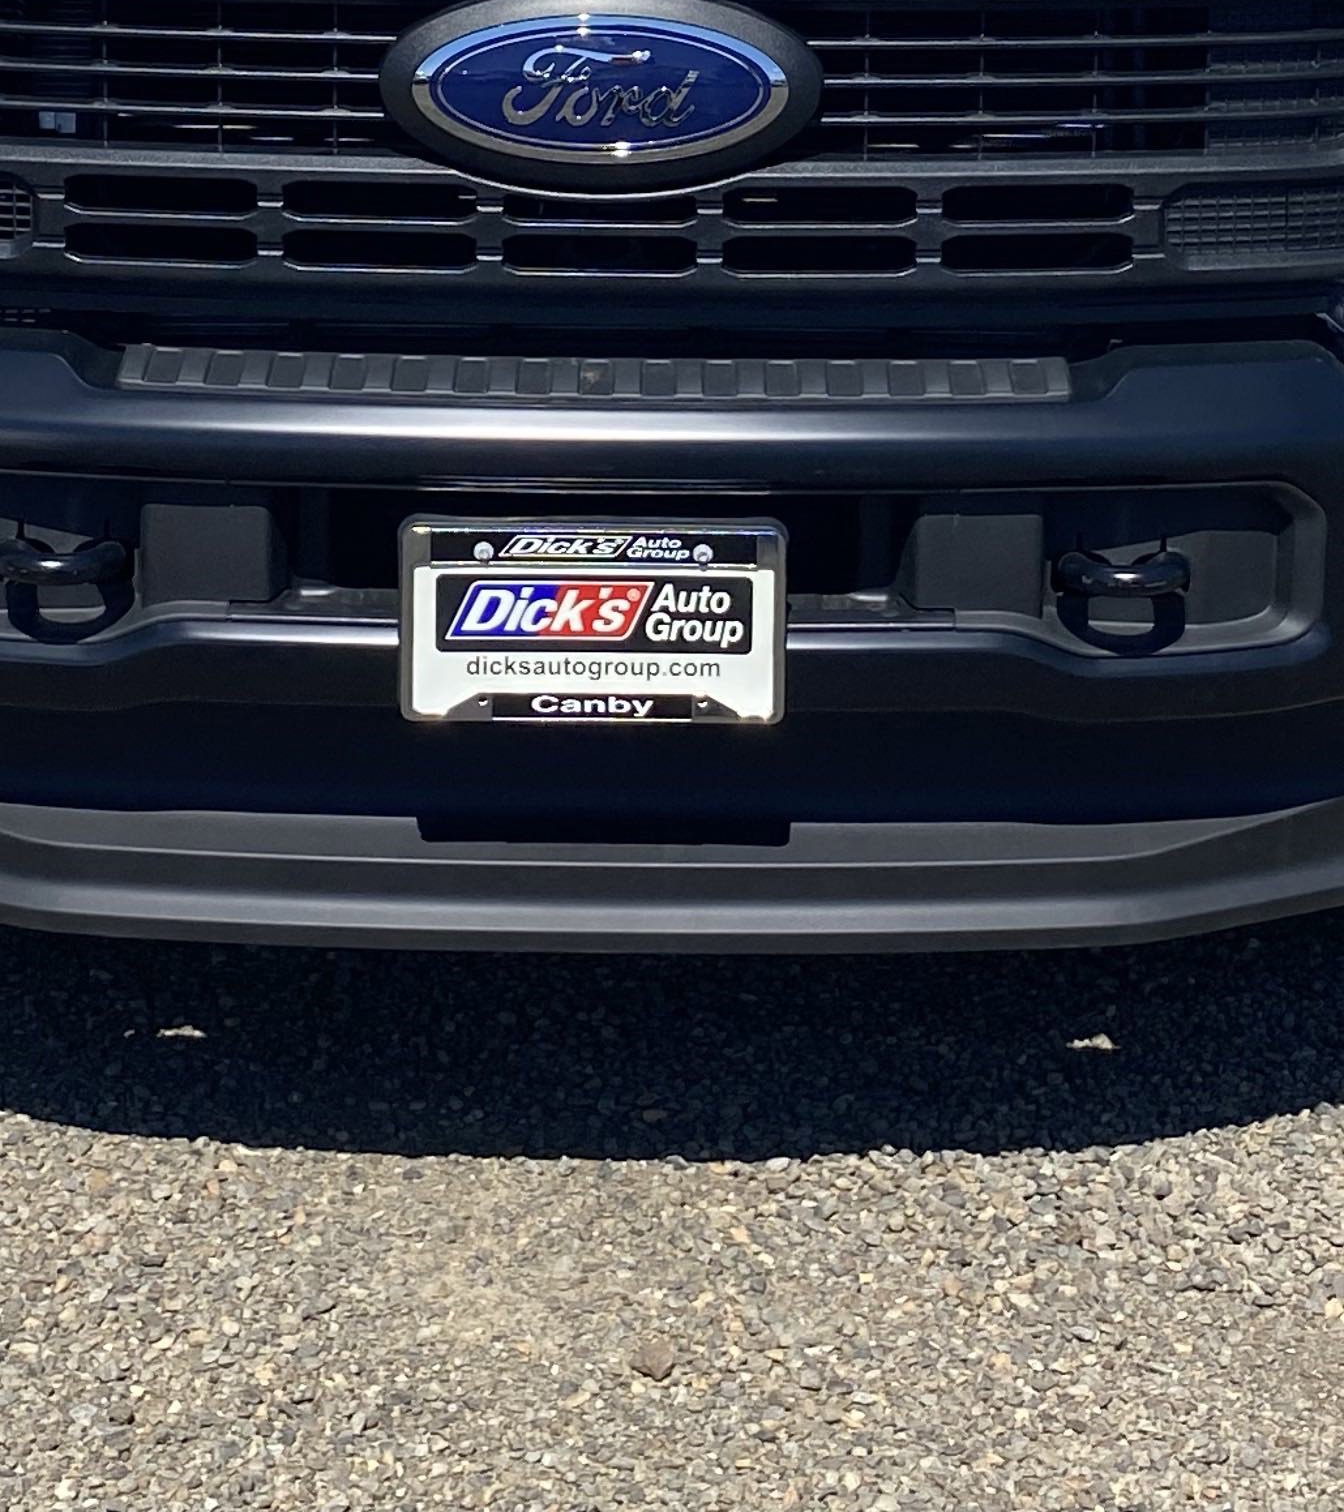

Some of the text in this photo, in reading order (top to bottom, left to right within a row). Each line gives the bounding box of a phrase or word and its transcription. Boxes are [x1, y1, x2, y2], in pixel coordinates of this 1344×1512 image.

[502, 44, 700, 127] Ford
[509, 535, 691, 561] Dick's Auto Group
[461, 583, 744, 648] Dick's Auto Group
[466, 655, 721, 680] dicksautogroup.com
[531, 695, 654, 718] Canby
